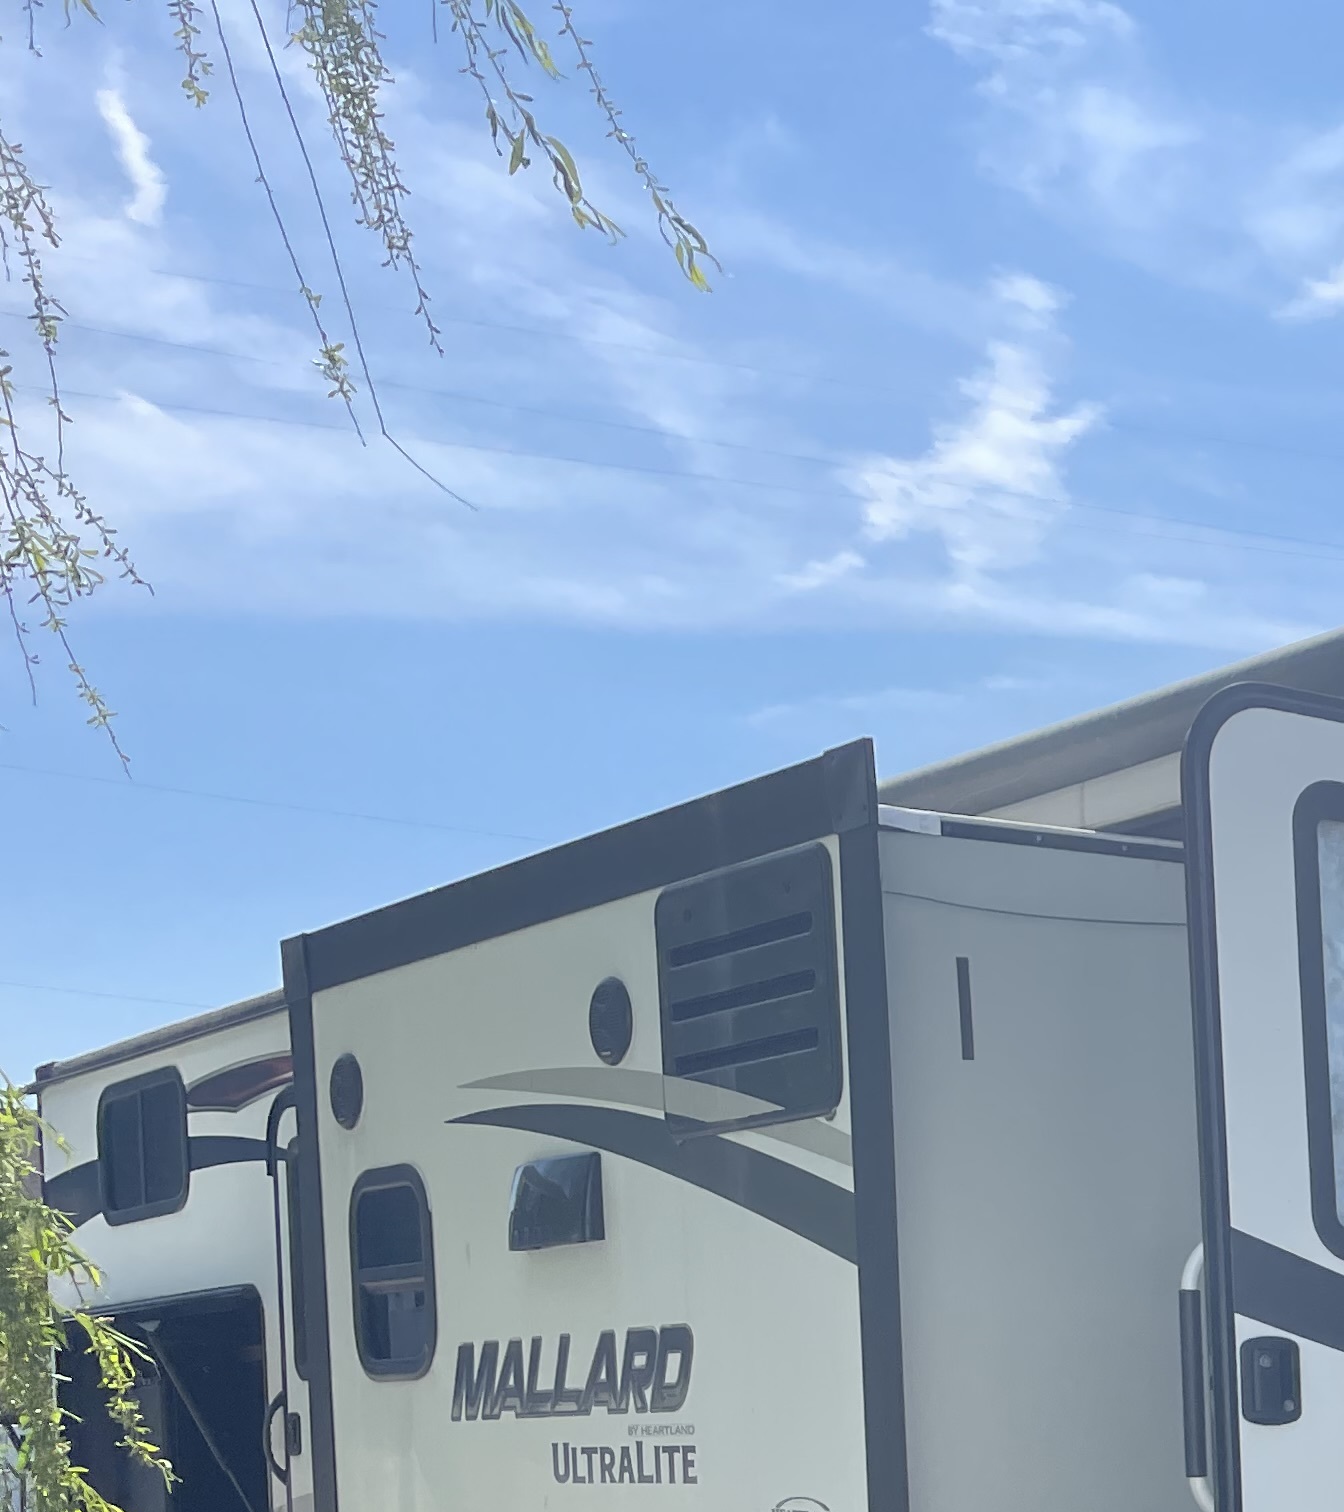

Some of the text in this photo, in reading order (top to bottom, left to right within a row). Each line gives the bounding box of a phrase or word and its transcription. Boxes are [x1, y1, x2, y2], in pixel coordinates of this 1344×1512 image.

[451, 1322, 694, 1422] MALLARD
[627, 1424, 696, 1436] BY HEARTLAND
